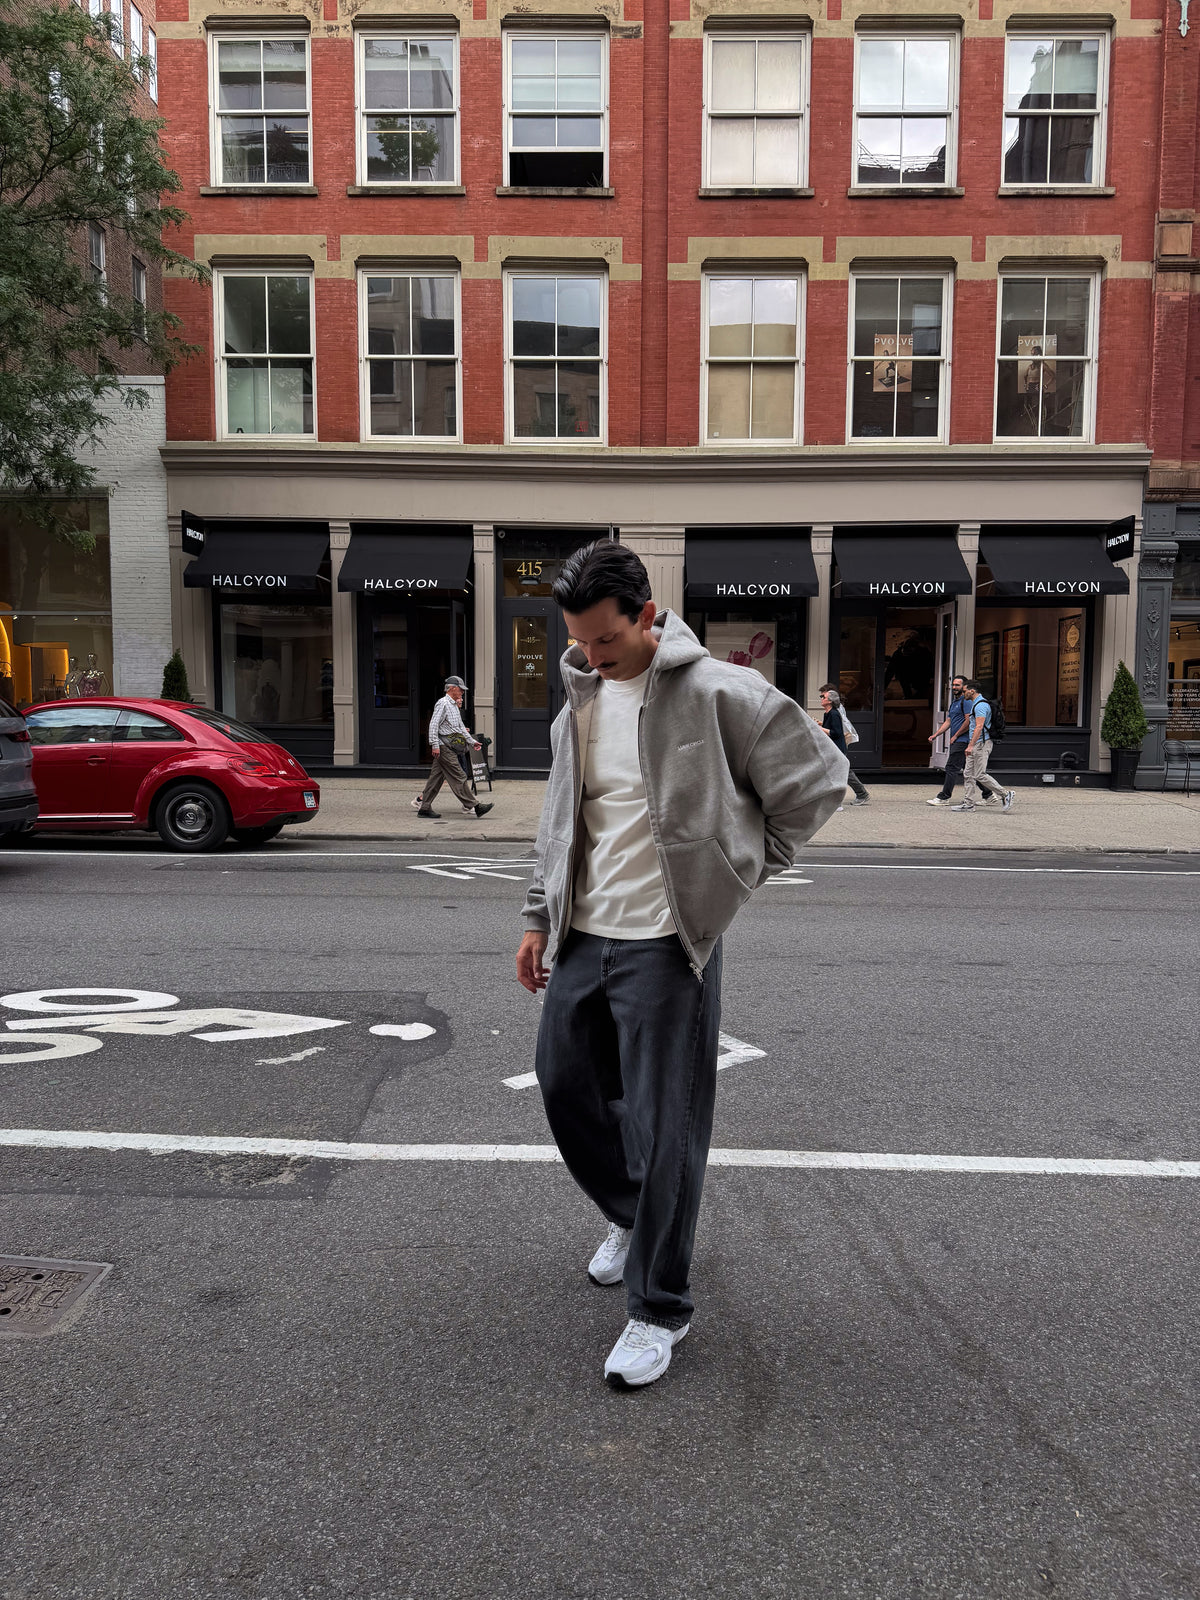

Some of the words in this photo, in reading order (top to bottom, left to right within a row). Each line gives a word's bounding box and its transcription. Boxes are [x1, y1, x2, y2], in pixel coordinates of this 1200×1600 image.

[874, 337, 914, 346] PVOVE
[1107, 533, 1130, 548] HALCYON
[516, 561, 543, 576] 415
[212, 575, 287, 587] HALCYON
[364, 578, 438, 589] HALCYON
[1025, 581, 1100, 593] HALCYON
[716, 583, 791, 595] HALCYON
[869, 582, 945, 594] HALCYON
